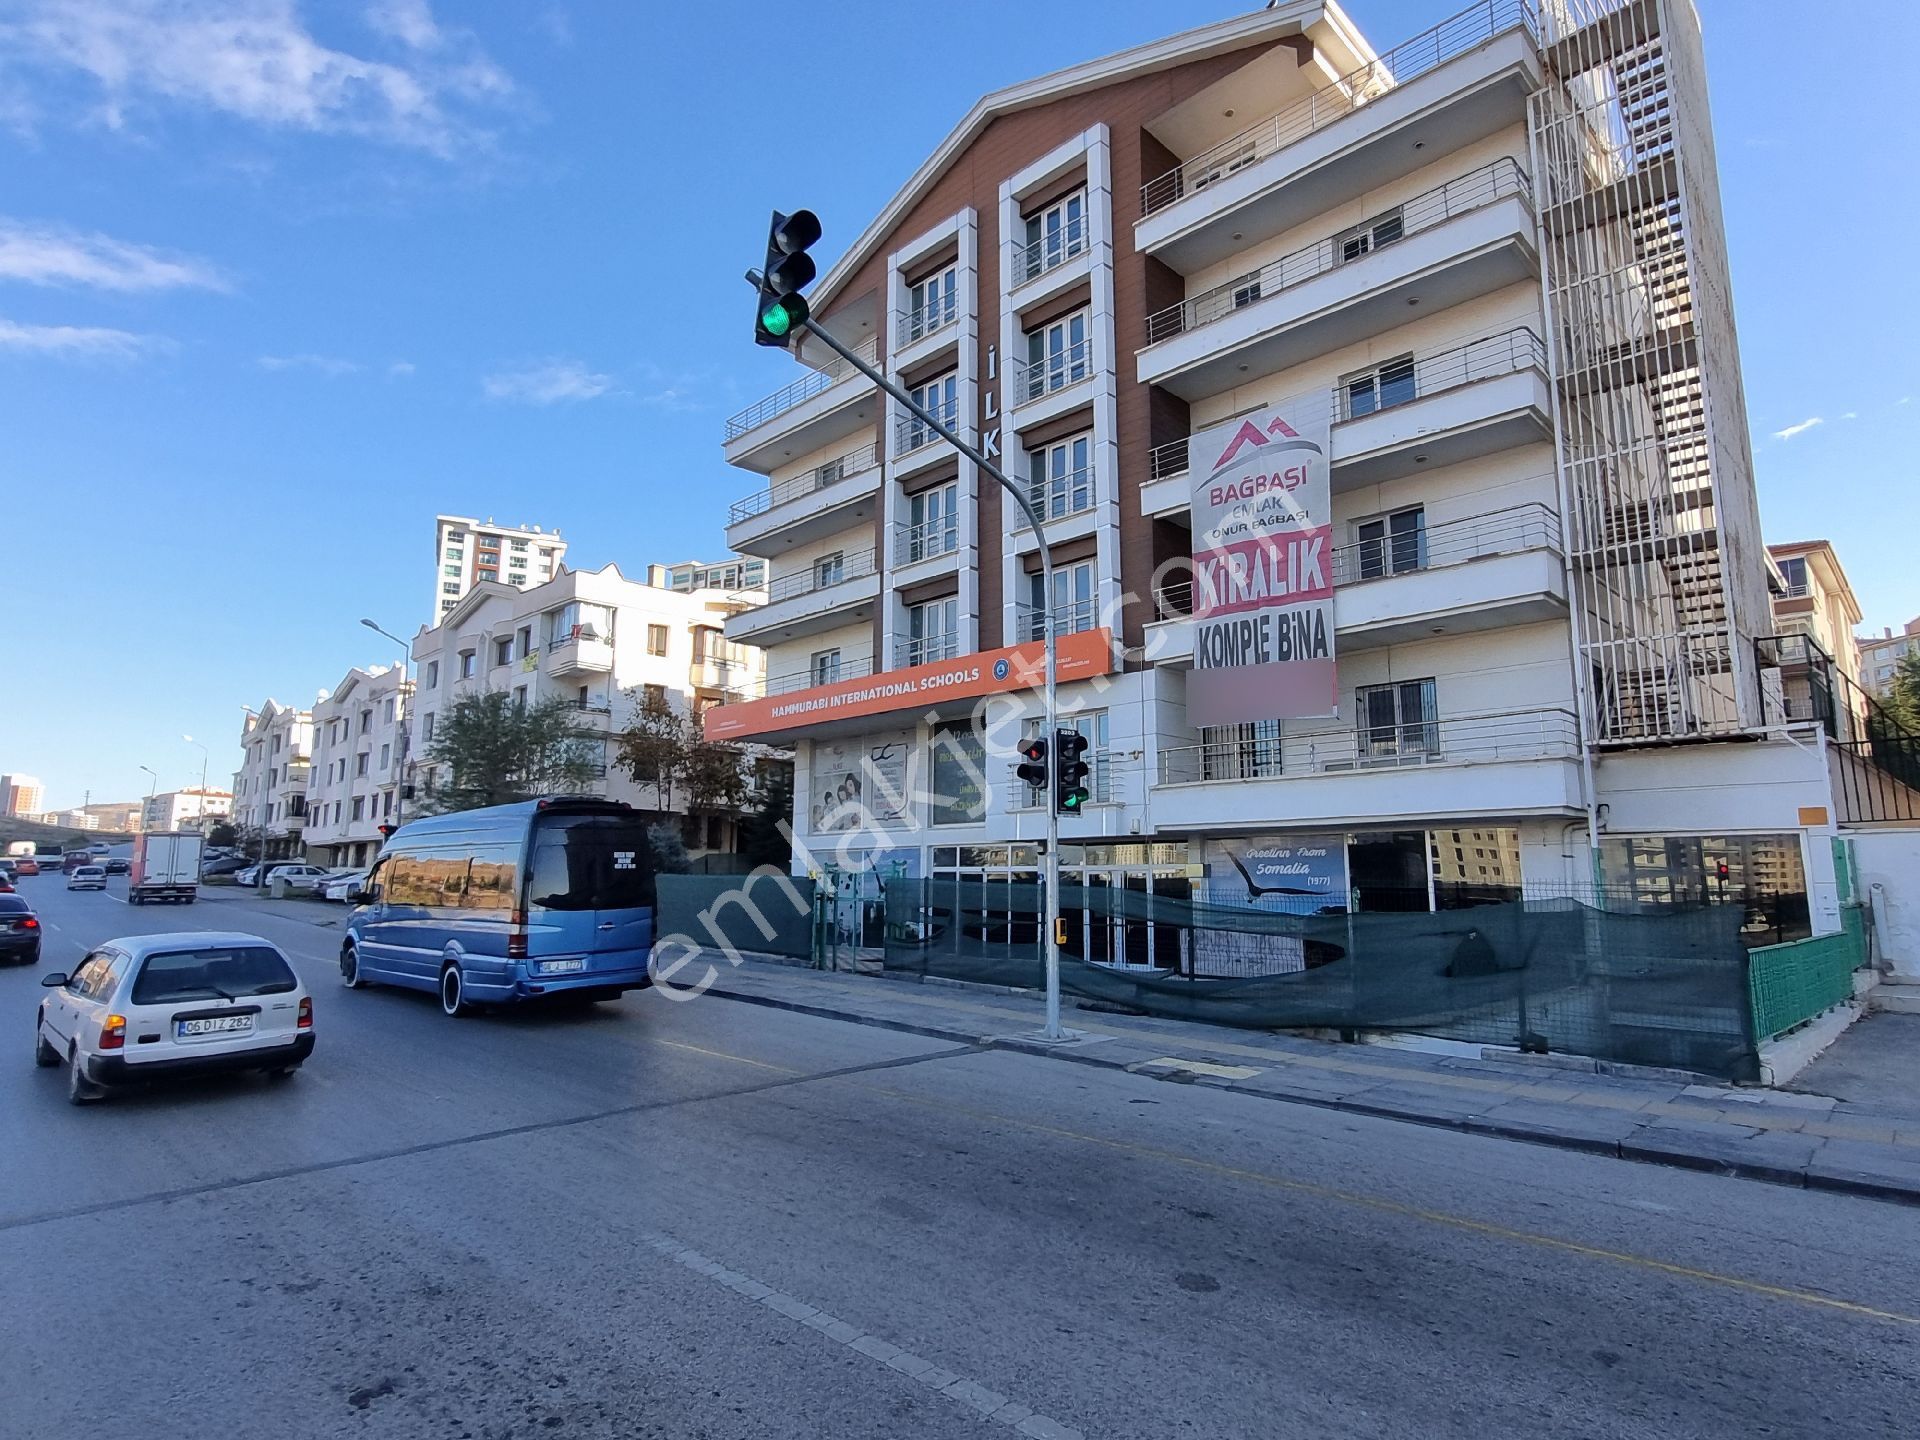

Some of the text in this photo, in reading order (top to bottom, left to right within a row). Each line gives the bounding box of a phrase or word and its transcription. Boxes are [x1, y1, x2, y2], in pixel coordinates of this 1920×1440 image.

[1210, 465, 1307, 507] BAĞBAŞI
[1232, 495, 1283, 519] EMLAK
[1212, 510, 1309, 539] ONUR BAĞBAŞI
[830, 680, 917, 707] INTERNATIONAL
[920, 667, 979, 691] SCHOOLS
[1296, 847, 1327, 857] From
[1256, 861, 1311, 875] Somalia
[1307, 876, 1331, 886] (1977)
[186, 1021, 201, 1032] 06
[228, 1016, 251, 1028] 282
